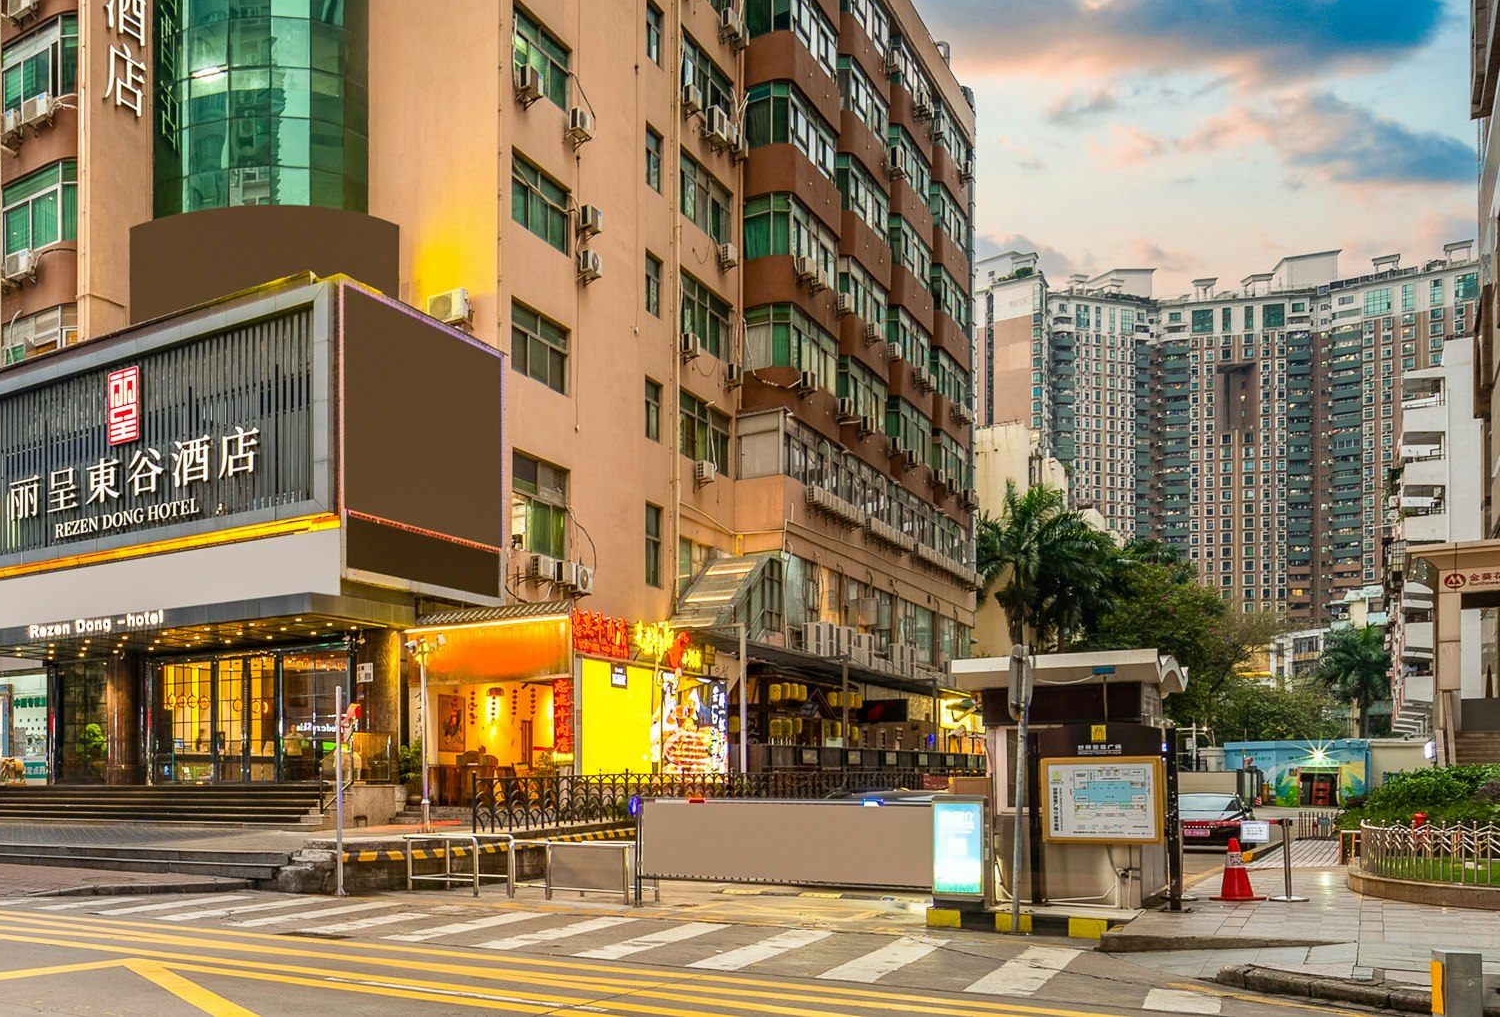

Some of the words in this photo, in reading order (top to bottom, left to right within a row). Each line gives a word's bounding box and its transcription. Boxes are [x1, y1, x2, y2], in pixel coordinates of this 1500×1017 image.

[9, 425, 260, 521] 丽呈東谷酒店
[55, 516, 100, 539] REZEN
[102, 507, 144, 530] DONG
[147, 497, 200, 521] HOTEL
[29, 623, 70, 639] Rezen
[75, 618, 112, 633] Dong
